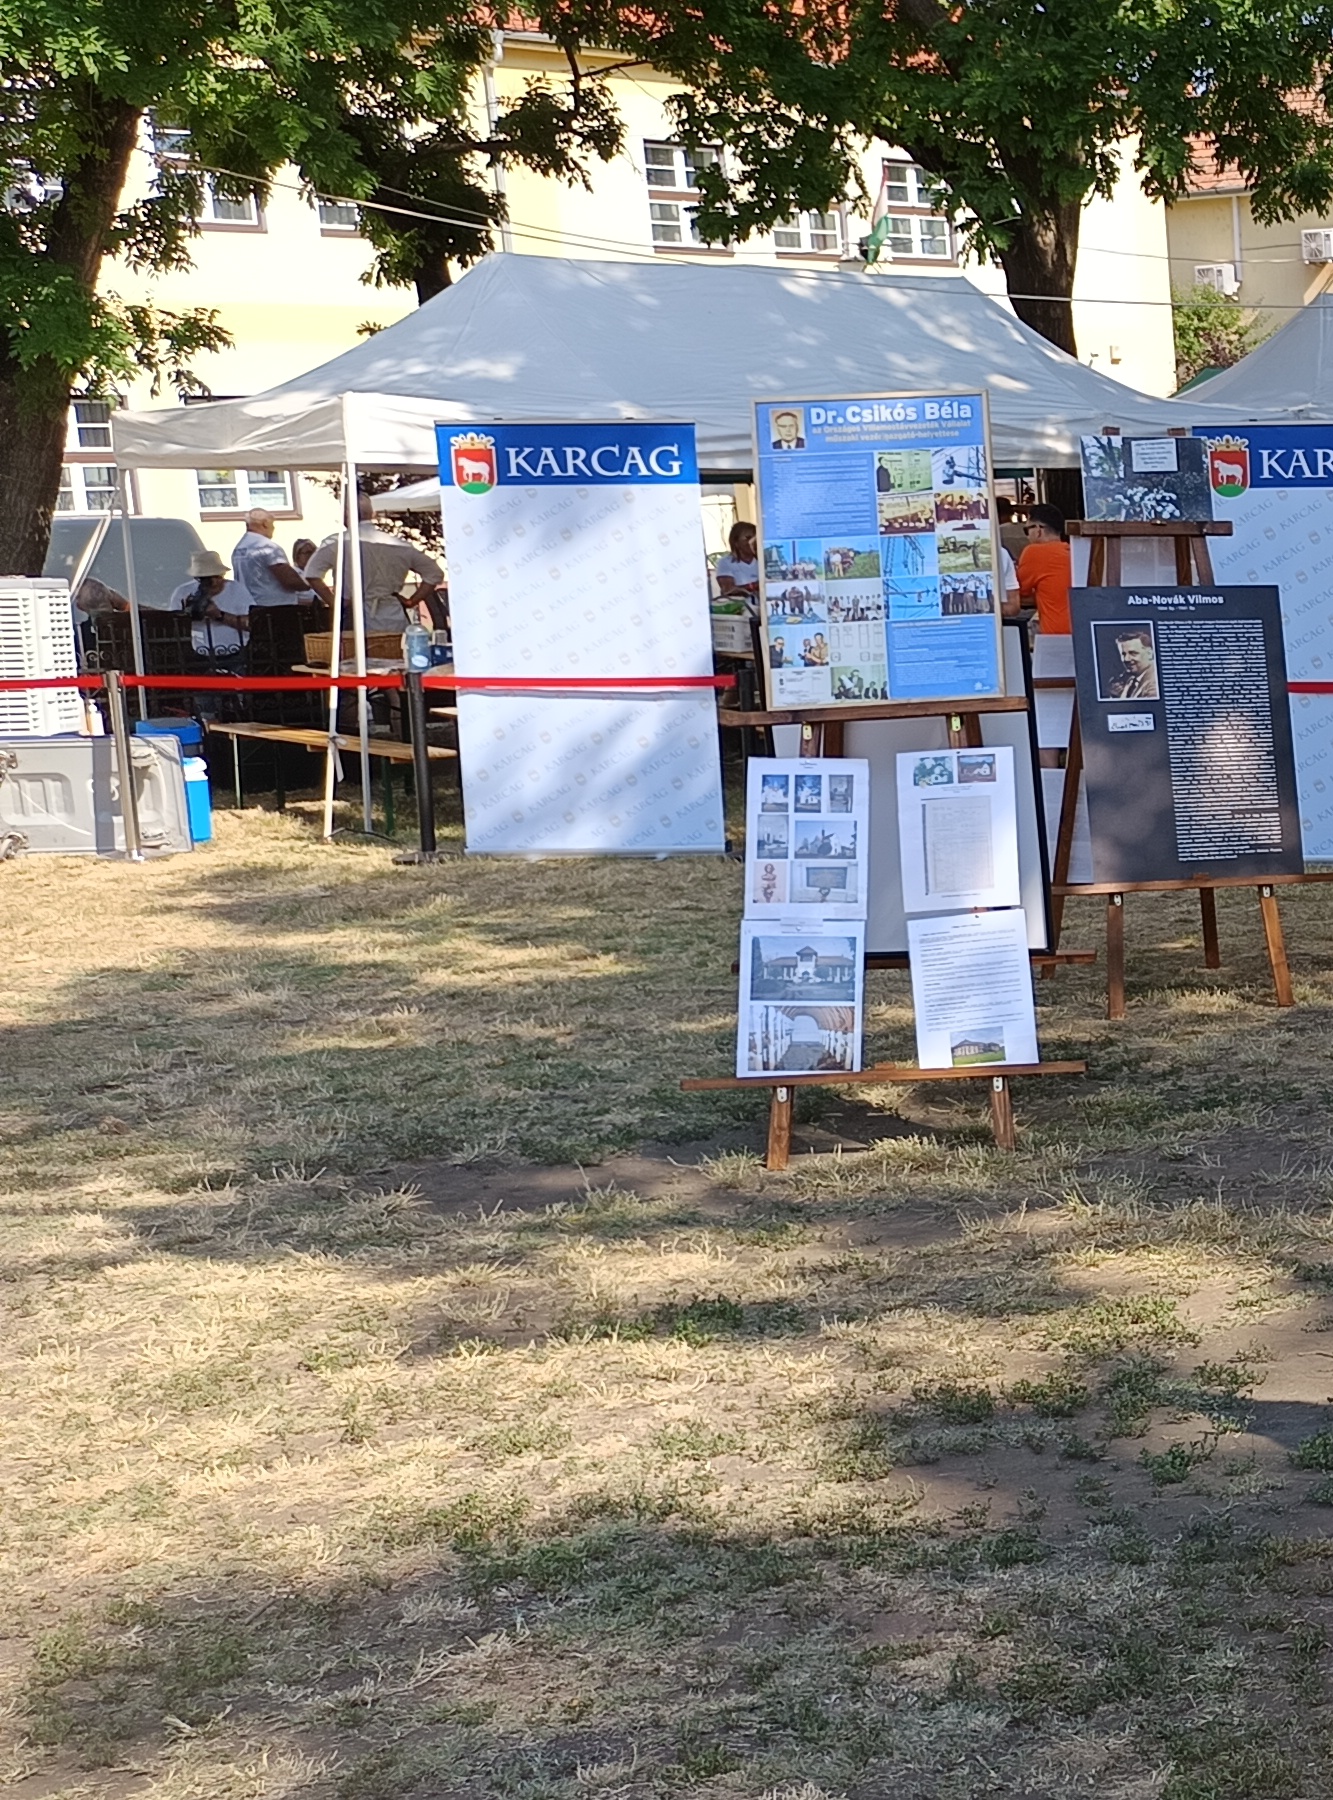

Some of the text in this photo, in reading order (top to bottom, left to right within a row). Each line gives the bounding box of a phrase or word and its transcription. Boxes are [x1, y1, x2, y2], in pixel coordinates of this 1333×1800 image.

[924, 400, 972, 420] Béla
[505, 443, 683, 478] KARCAG
[478, 497, 522, 527] KARCAG
[529, 498, 574, 528] KARCAG
[575, 502, 620, 532] KARCAG
[1279, 499, 1323, 530] KARCAG
[466, 536, 510, 565] KARCAG
[513, 539, 557, 570] KARCAG
[1218, 537, 1261, 569] KARCAG
[1262, 541, 1305, 573] KARCAG
[501, 578, 545, 608] KARCAG
[1128, 594, 1224, 605] Aba-Novák Vilmos
[653, 708, 696, 739] KARCAG
[492, 741, 536, 771] KARCAG
[544, 742, 588, 772] KARCAG
[641, 748, 685, 777] KARCAG
[481, 779, 525, 809] KARCAG
[528, 783, 571, 813] KARCAG
[578, 784, 622, 815] KARCAG
[625, 787, 668, 818] KARCAG
[675, 789, 719, 819] KARCAG
